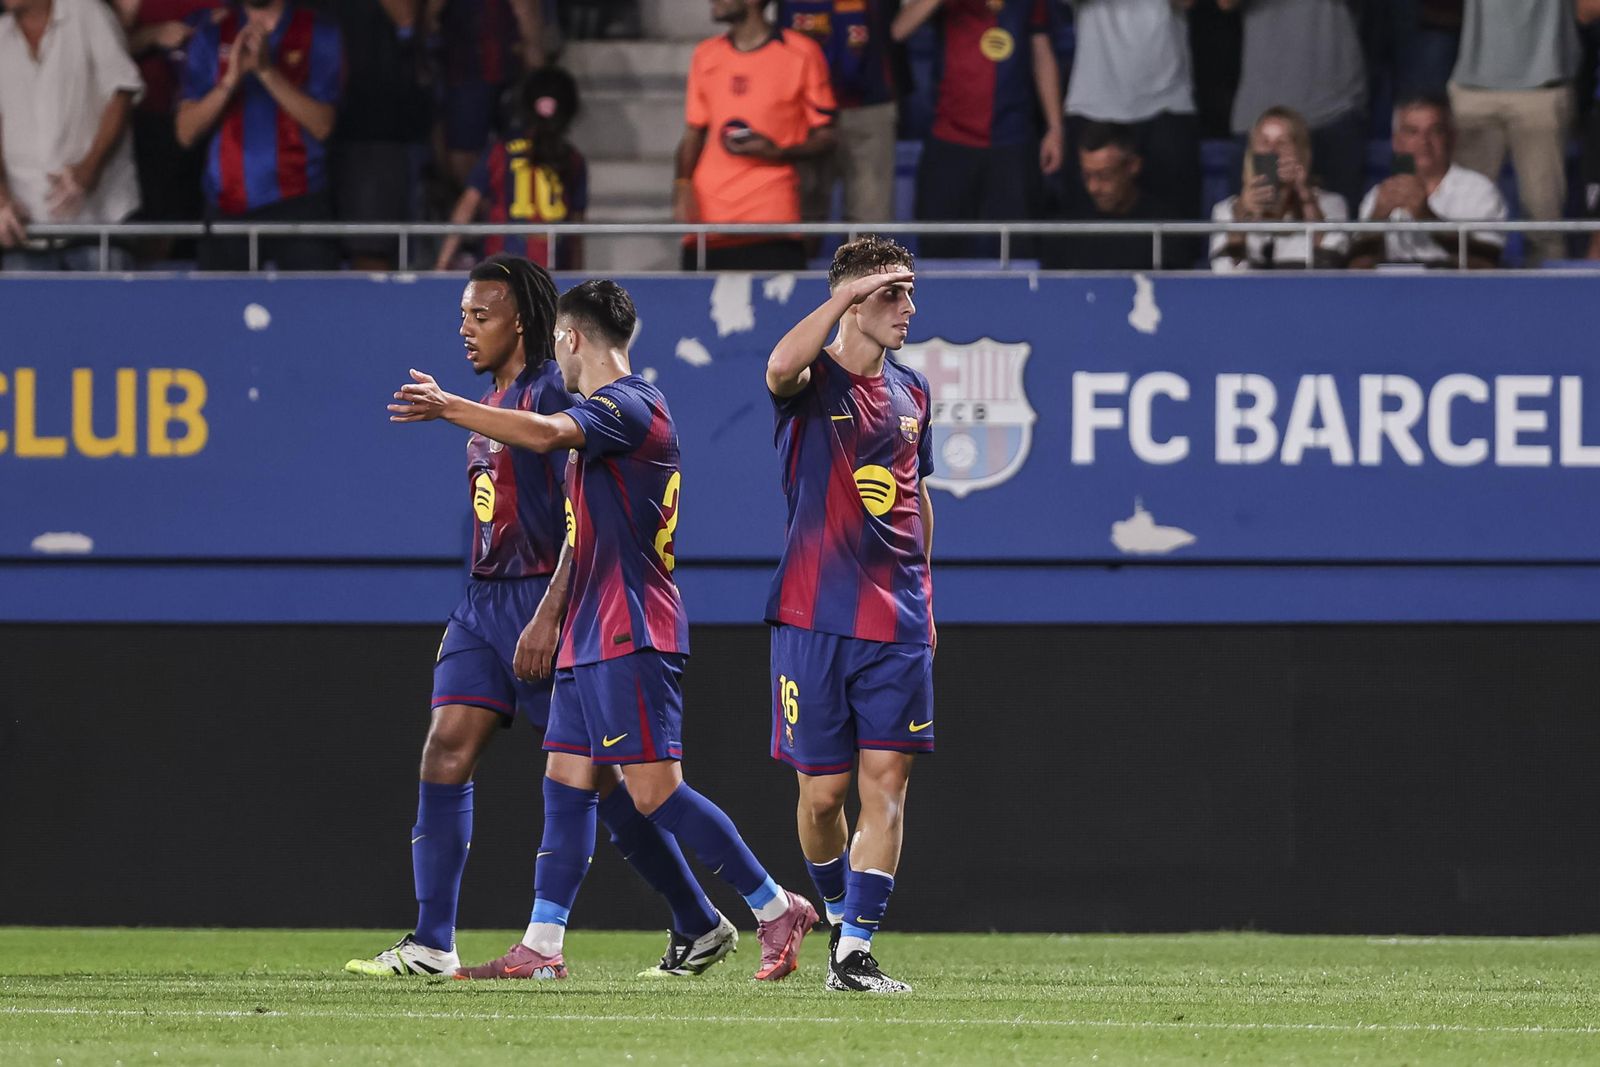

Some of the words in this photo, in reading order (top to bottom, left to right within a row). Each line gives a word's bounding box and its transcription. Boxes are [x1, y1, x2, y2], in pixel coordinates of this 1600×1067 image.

[0, 367, 208, 458] LUB
[1071, 370, 1190, 465] FC
[1214, 373, 1600, 467] BARCEL
[780, 674, 799, 724] 16
